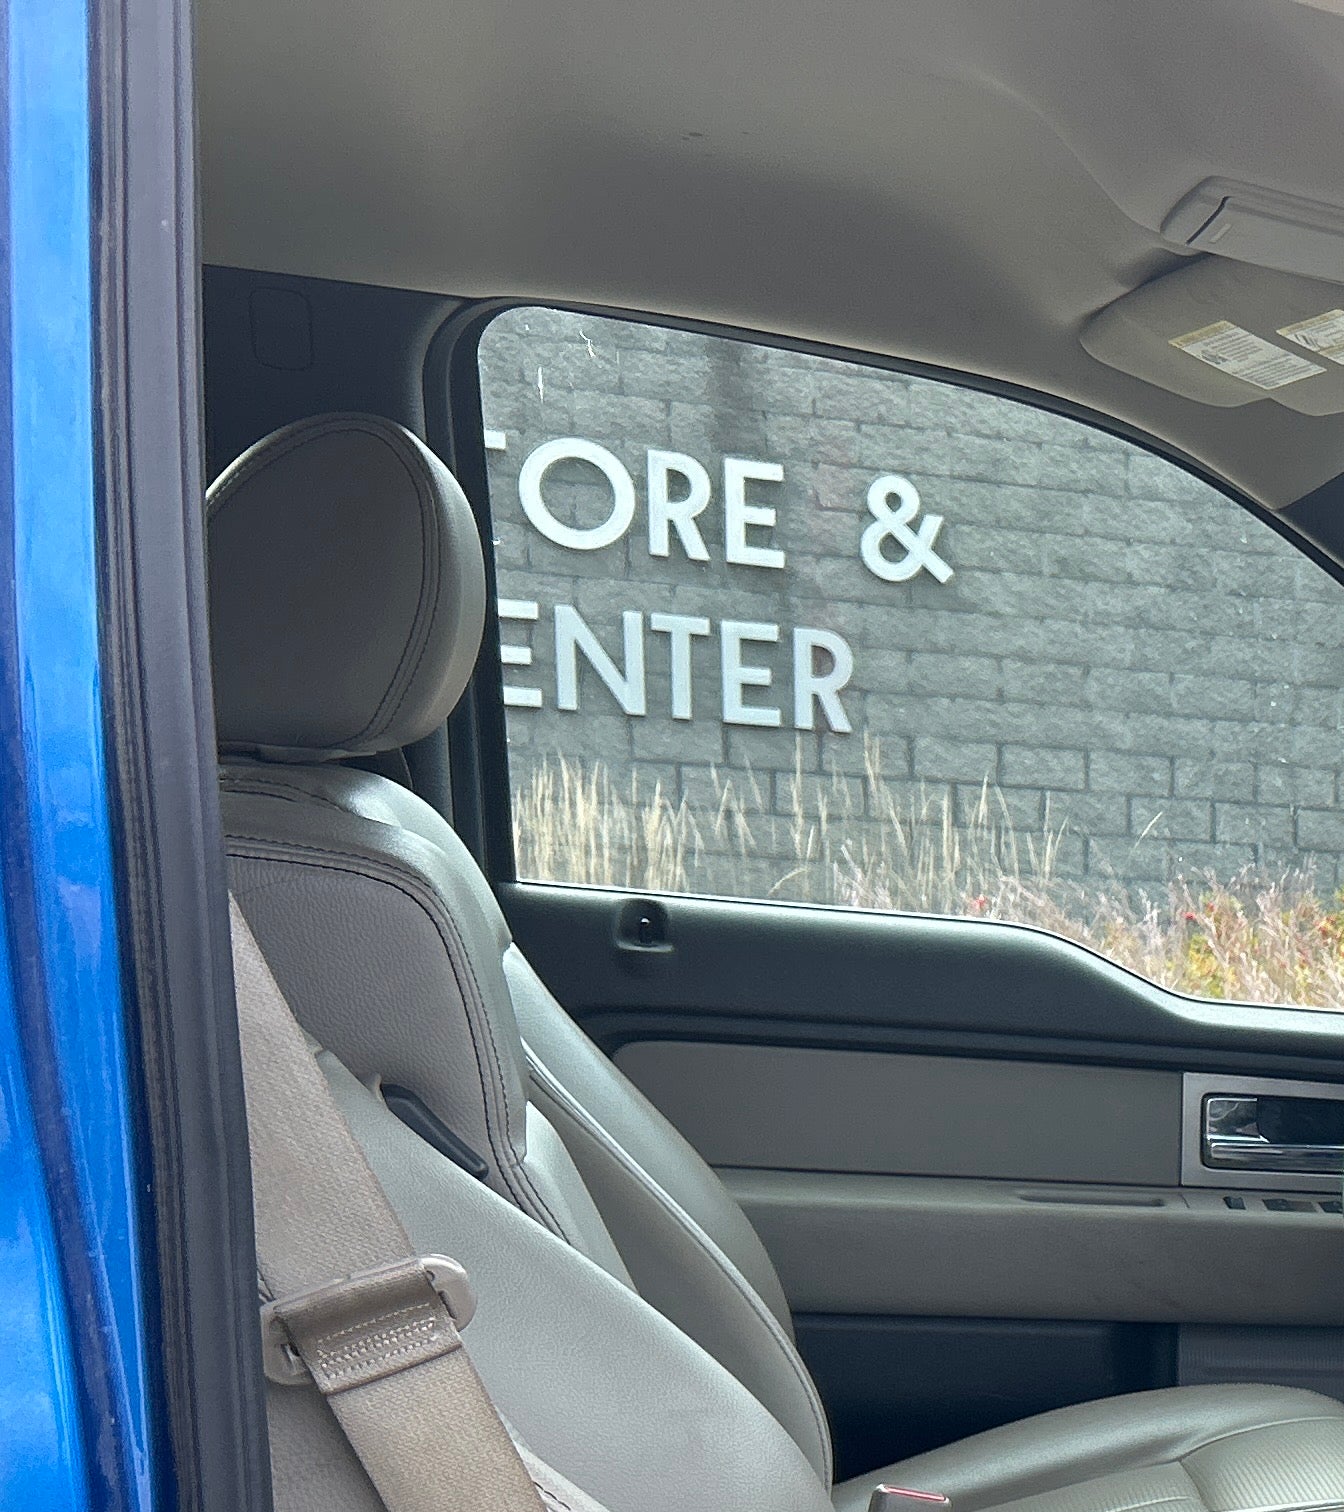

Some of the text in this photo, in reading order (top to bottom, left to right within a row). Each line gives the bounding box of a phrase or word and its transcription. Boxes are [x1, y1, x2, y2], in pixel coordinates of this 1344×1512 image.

[485, 429, 955, 584] ORE &
[498, 599, 855, 734] ENTER
